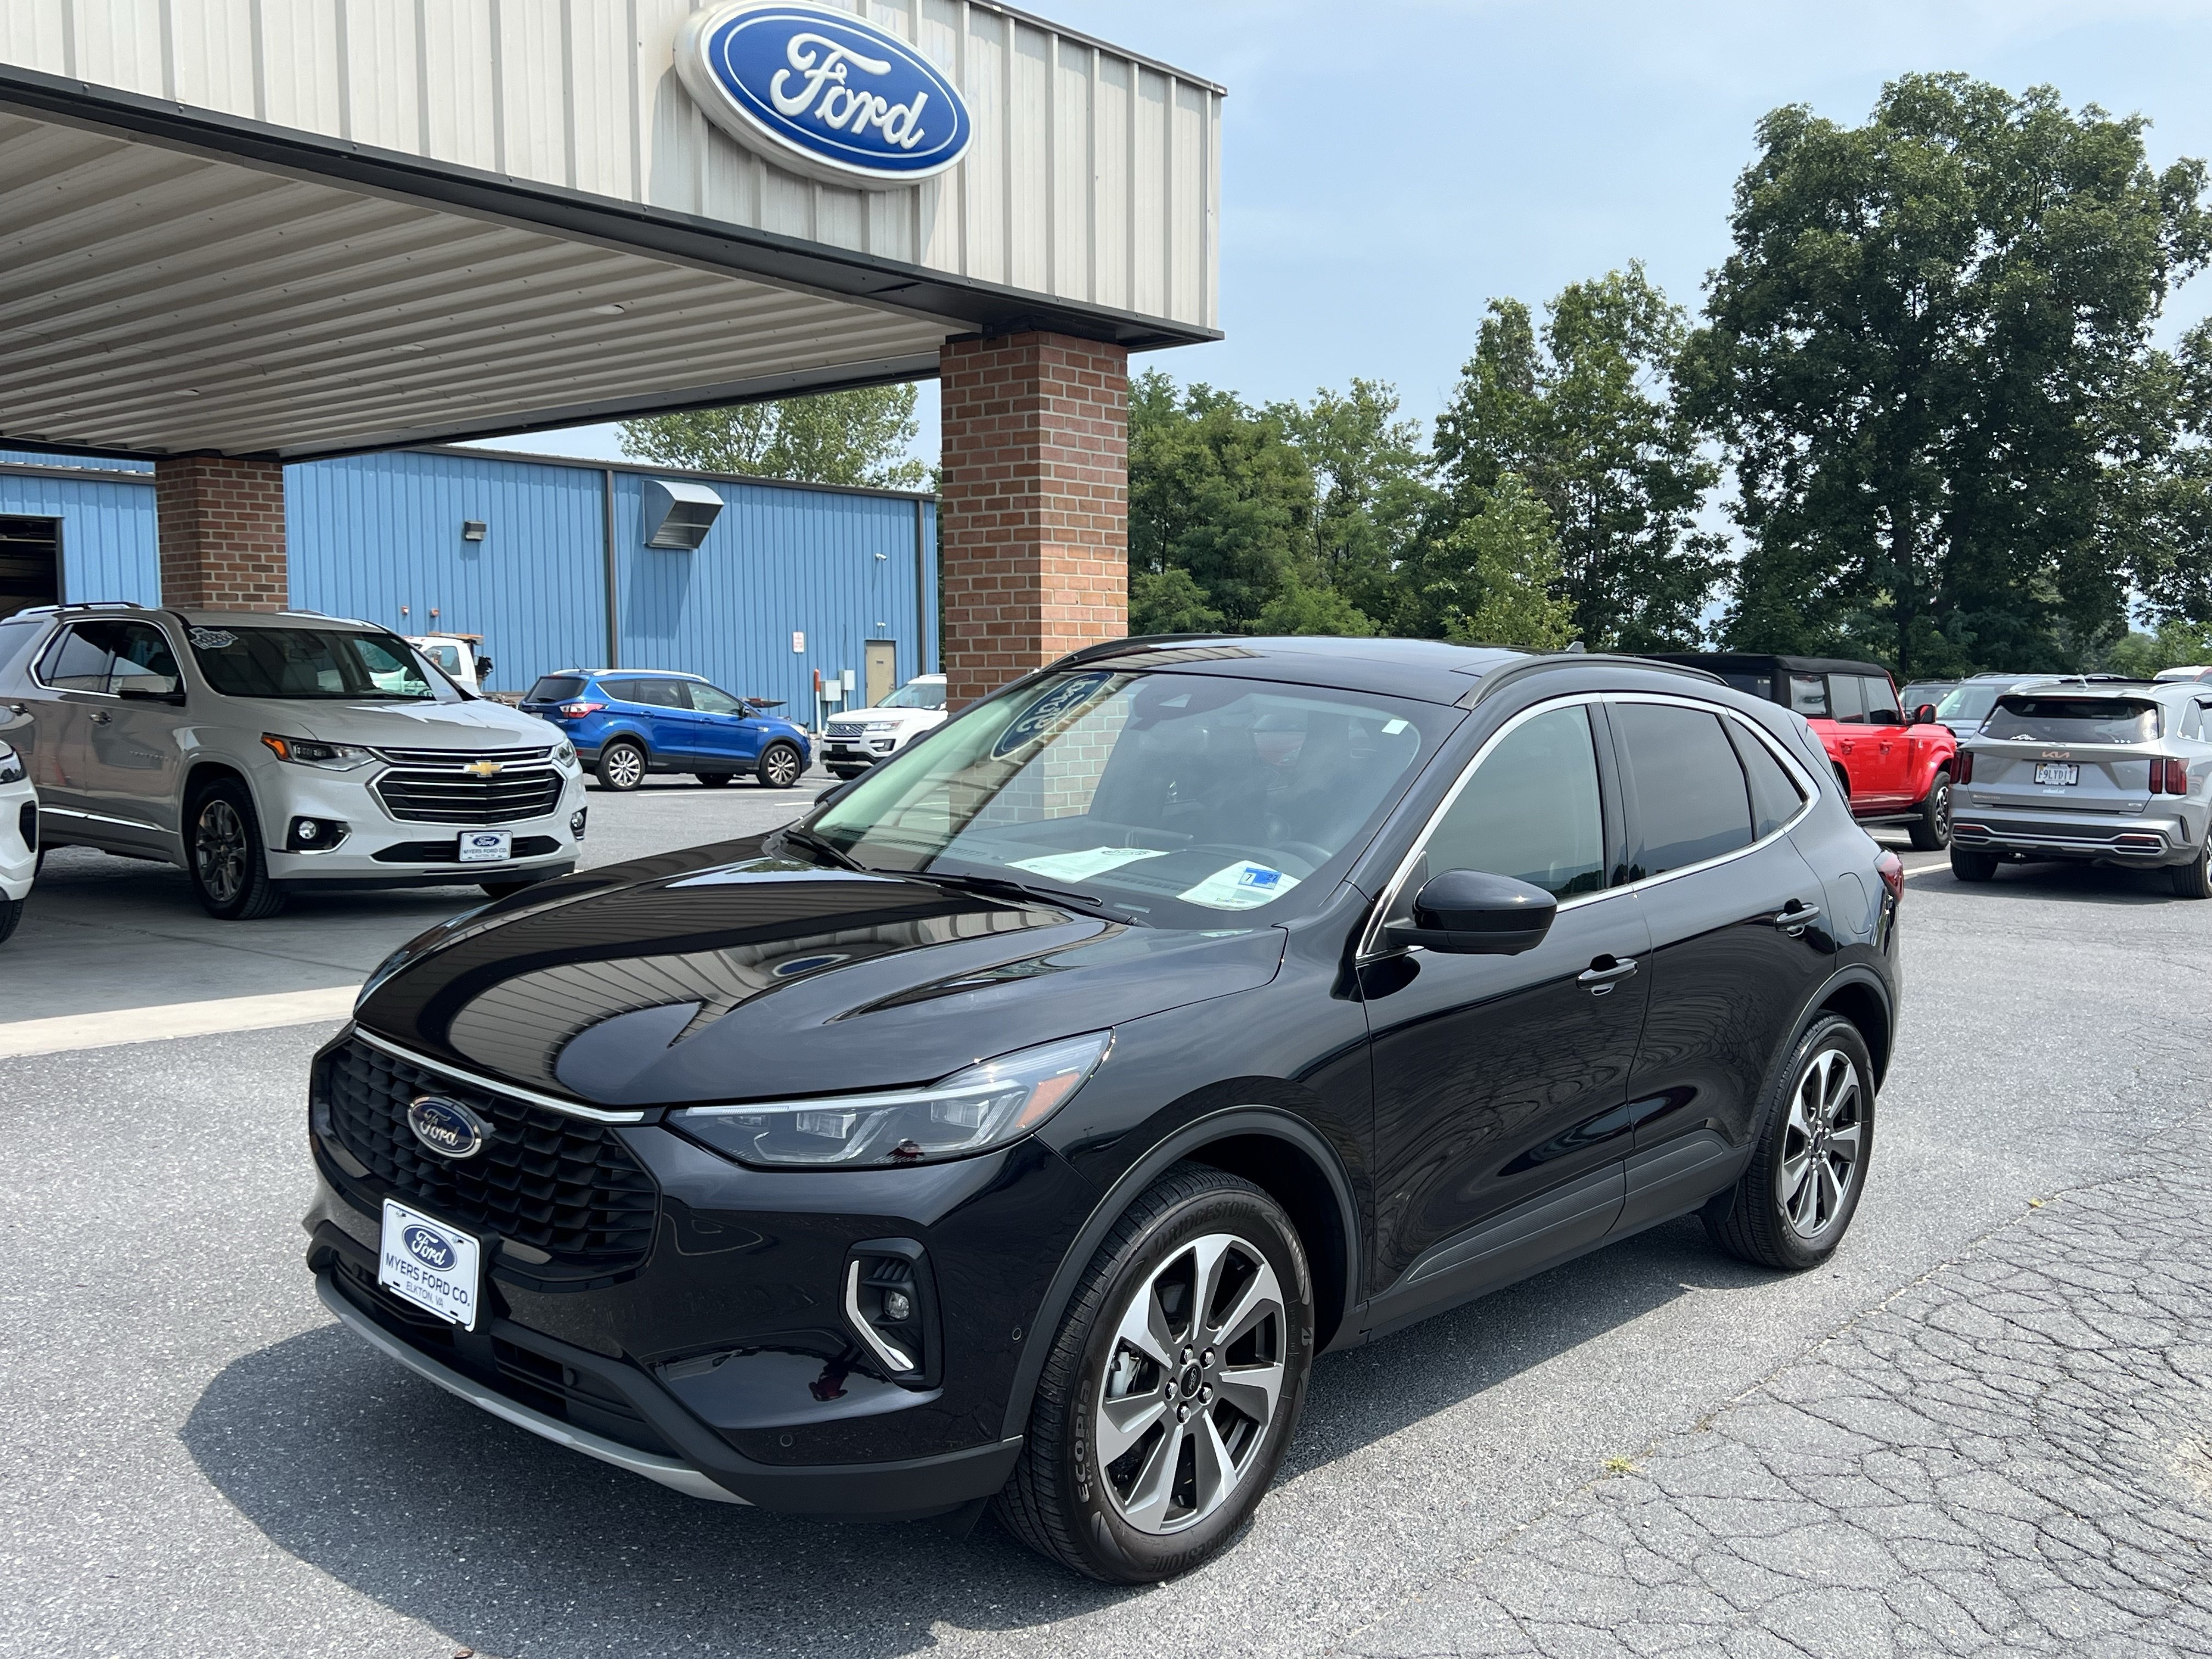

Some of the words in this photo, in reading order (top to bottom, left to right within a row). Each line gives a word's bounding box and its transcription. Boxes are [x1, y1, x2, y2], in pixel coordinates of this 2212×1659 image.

[770, 33, 928, 150] Ford
[1245, 873, 1253, 882] 7
[1266, 873, 1279, 882] 27
[420, 1108, 460, 1147] Ford
[411, 1230, 447, 1266] Ford
[1154, 1200, 1257, 1257] BRIDGESTONE
[385, 1252, 420, 1281] MYERS
[421, 1271, 450, 1295] FORD
[453, 1286, 470, 1306] CO.
[435, 1296, 444, 1307] VA
[1075, 1379, 1092, 1503] ECOPIA
